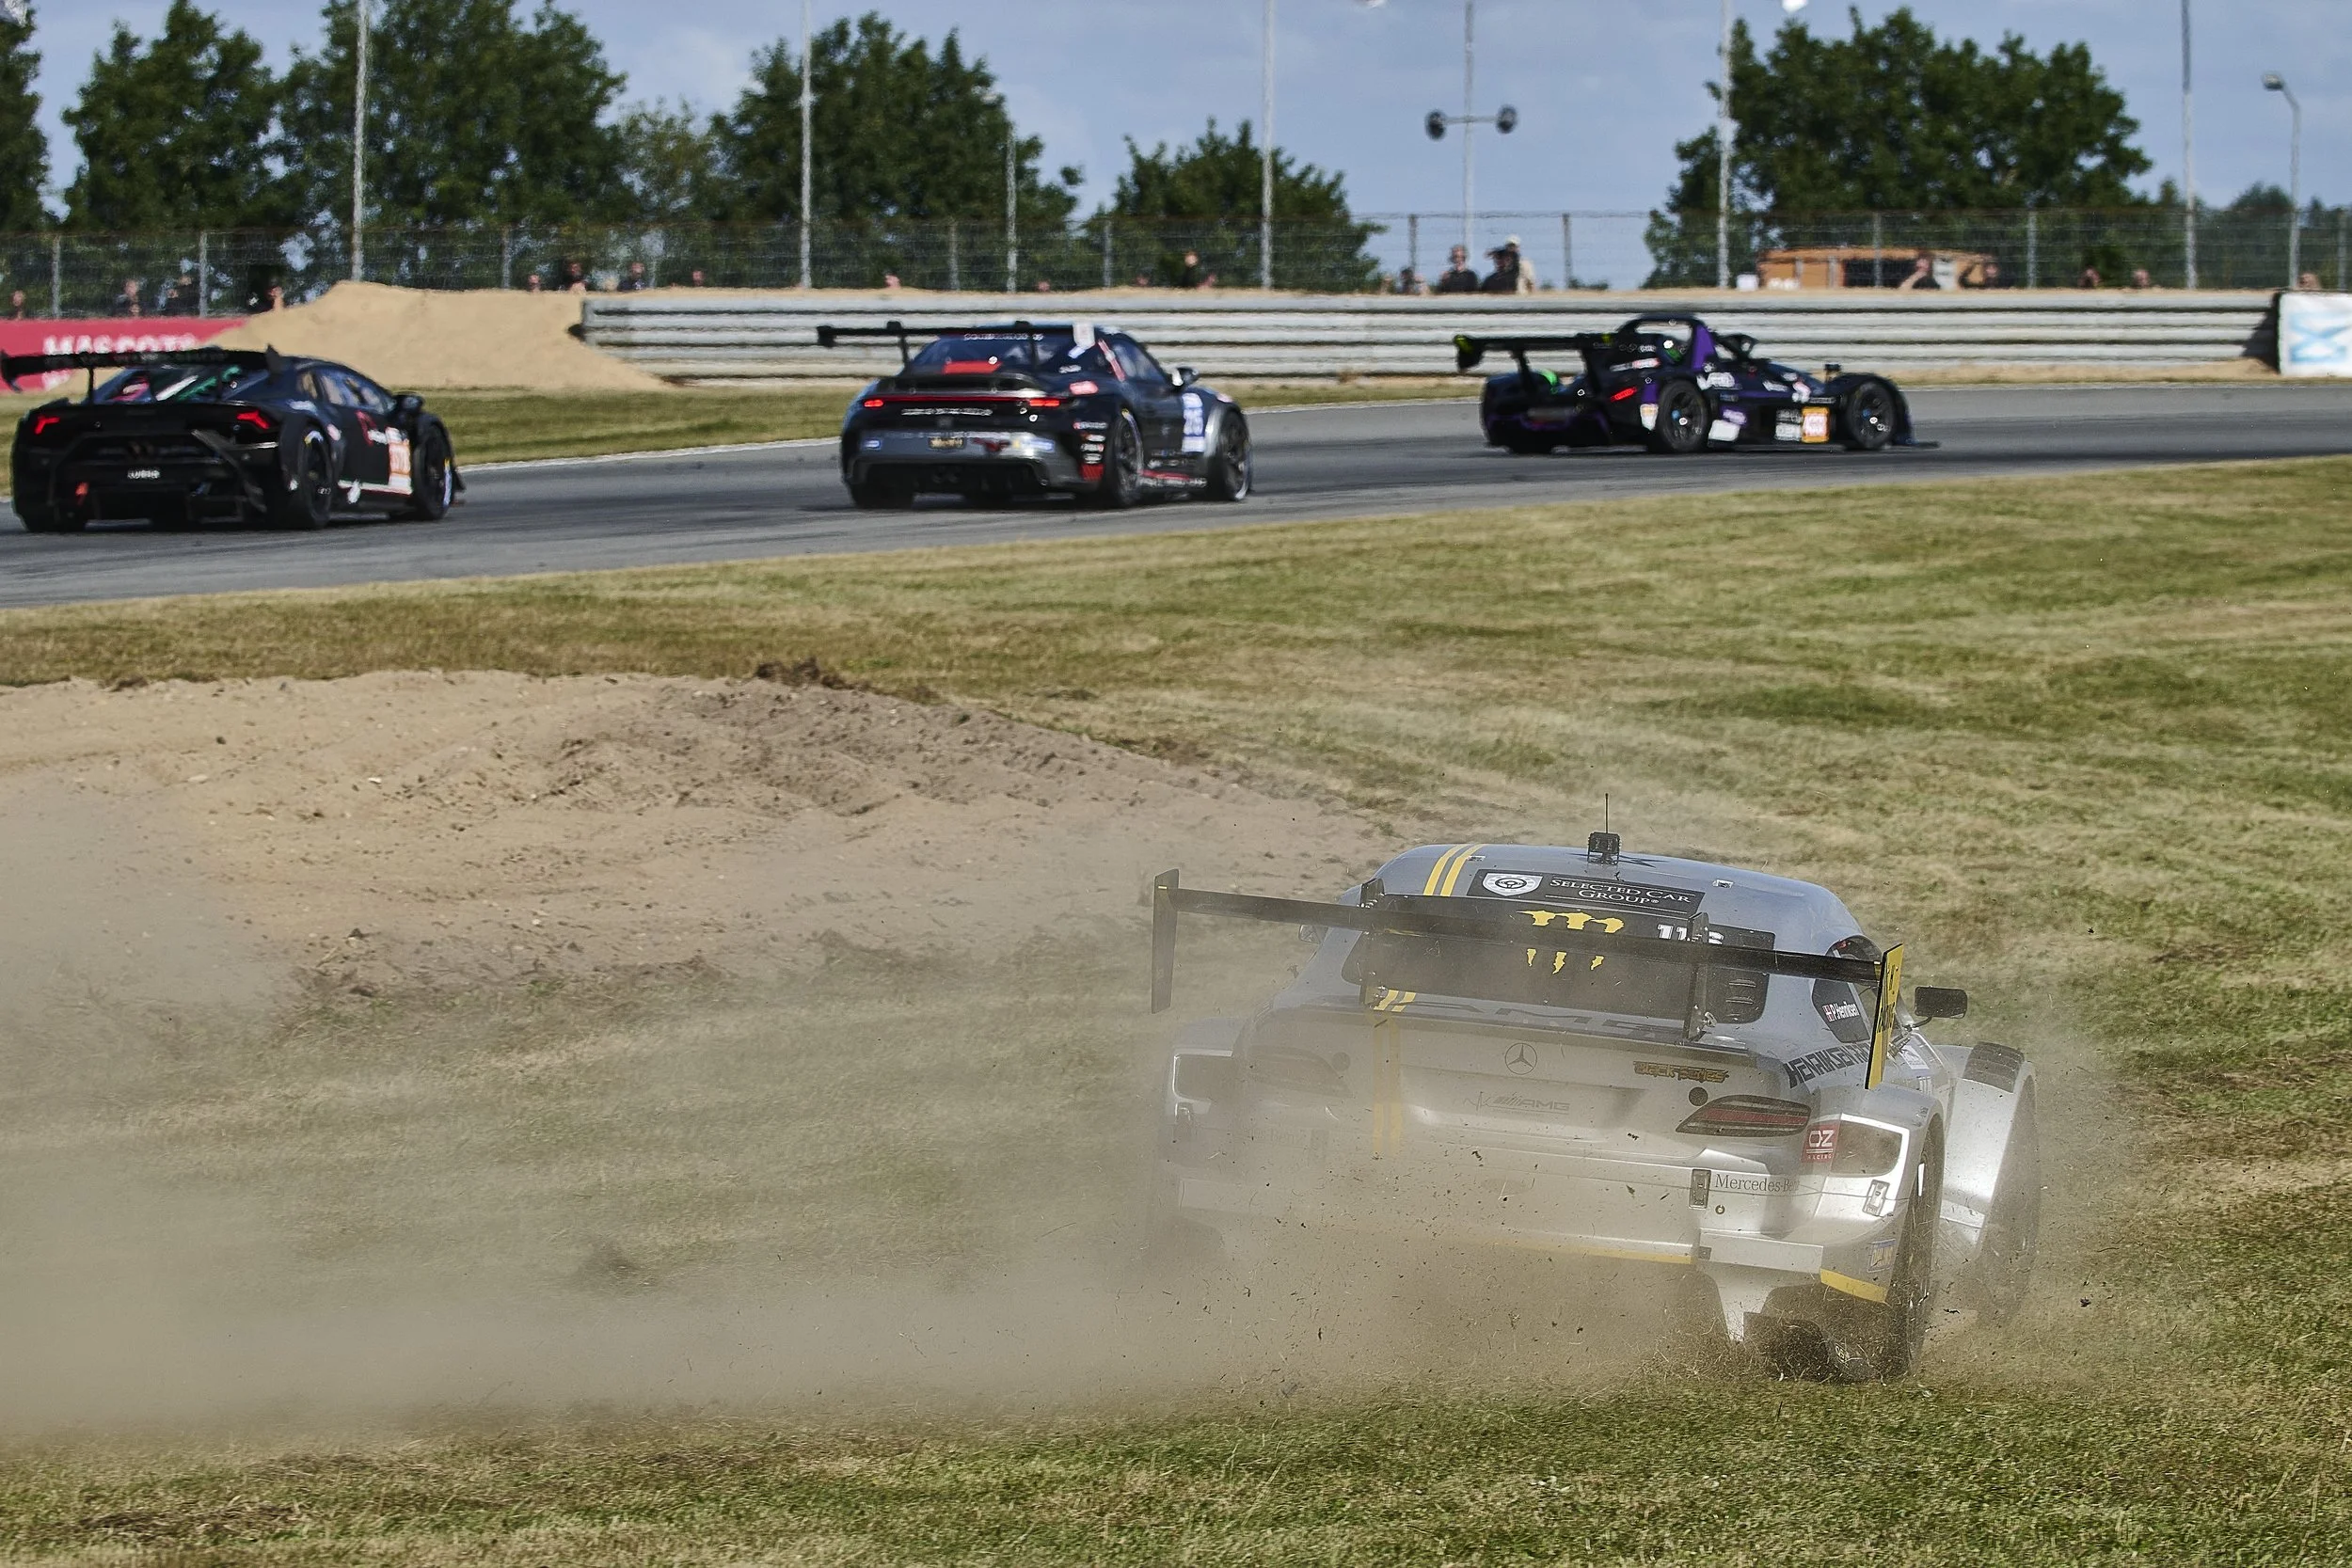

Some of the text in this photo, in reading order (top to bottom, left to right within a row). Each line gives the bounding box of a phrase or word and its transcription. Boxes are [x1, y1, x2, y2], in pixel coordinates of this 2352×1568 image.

[1549, 879, 1692, 903] SELECTED CAR
[1809, 1130, 1835, 1147] OZ
